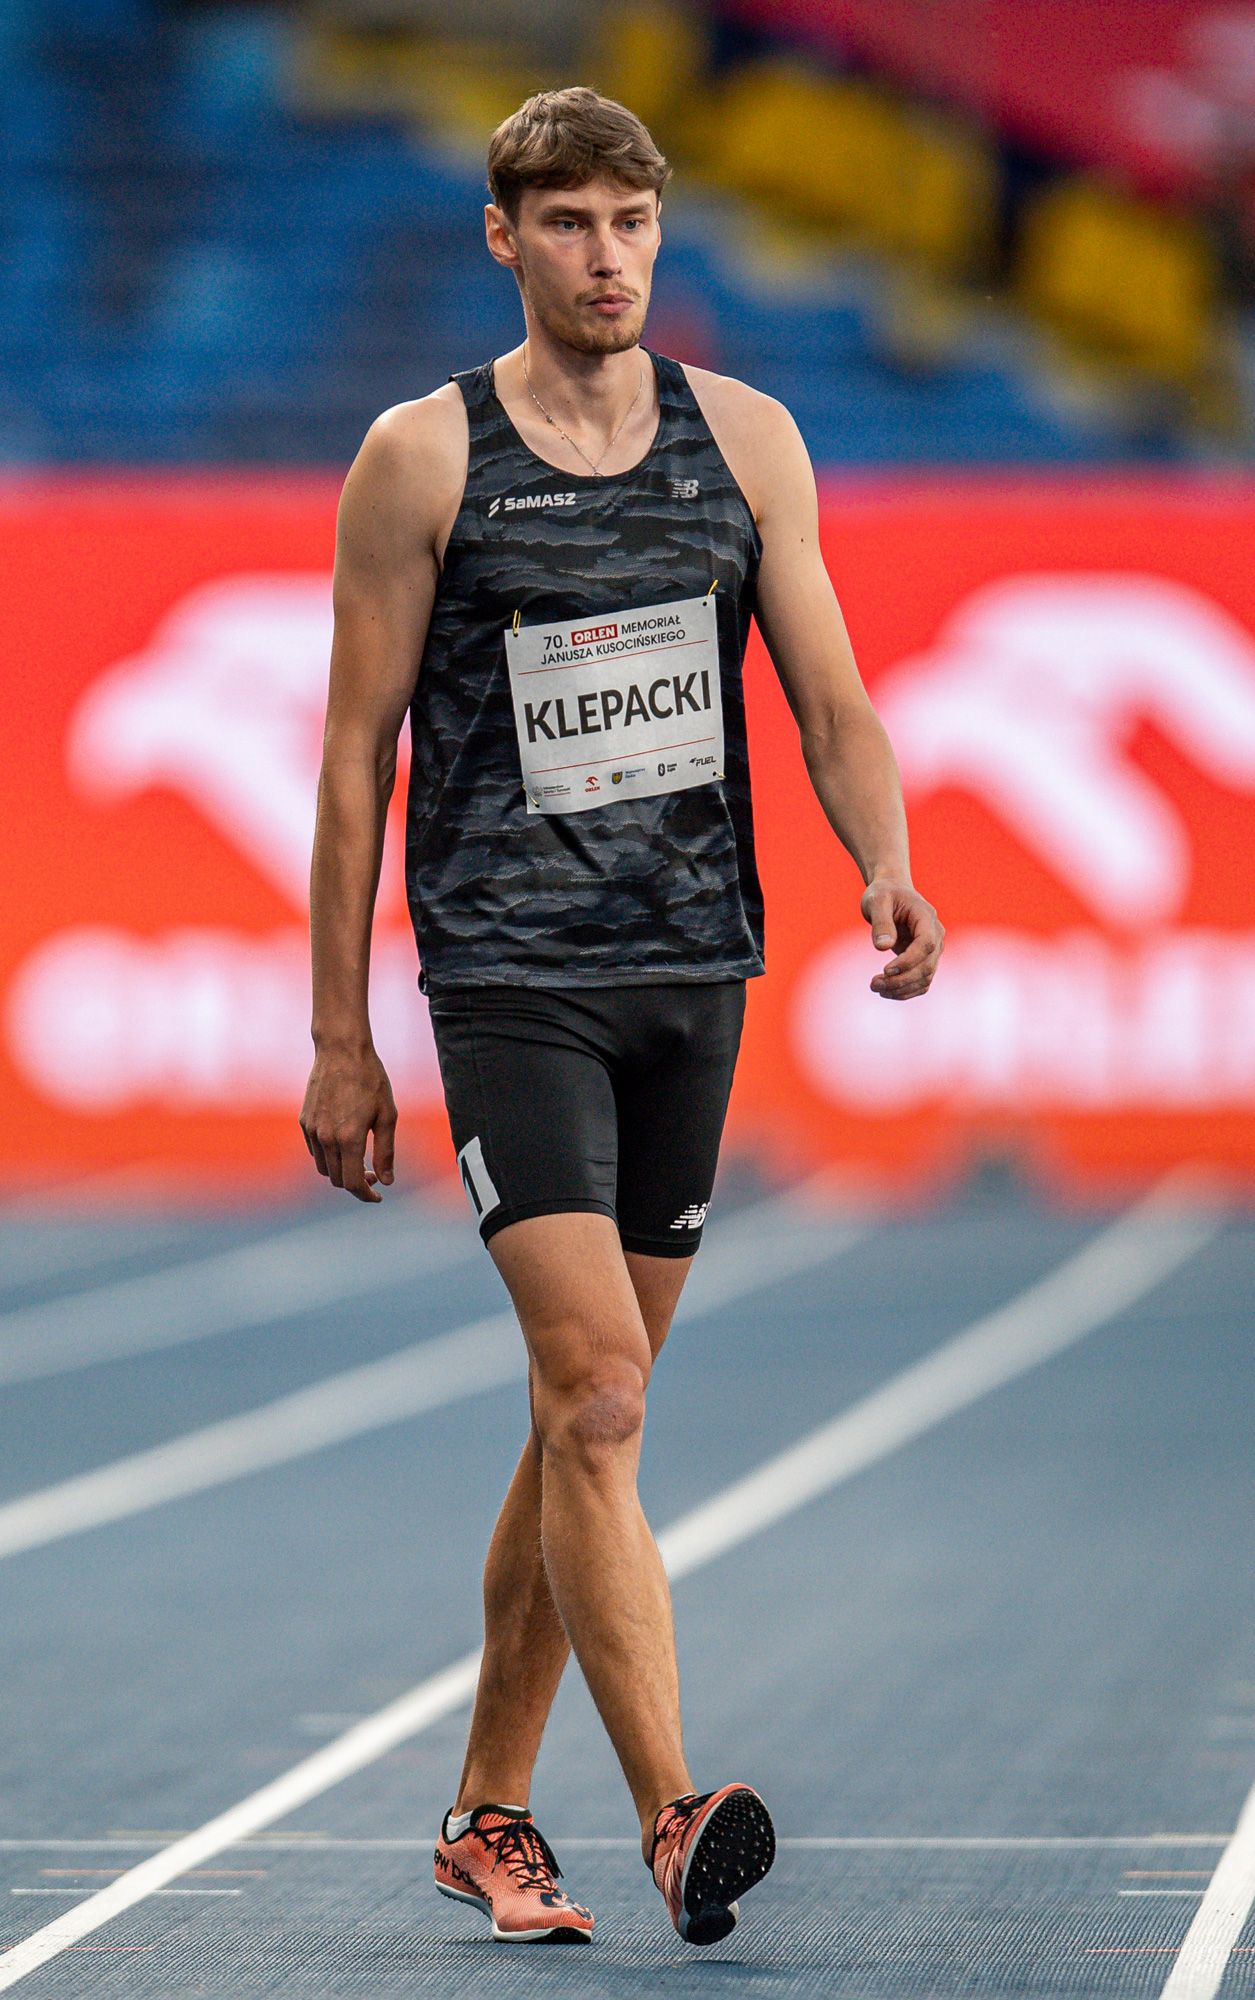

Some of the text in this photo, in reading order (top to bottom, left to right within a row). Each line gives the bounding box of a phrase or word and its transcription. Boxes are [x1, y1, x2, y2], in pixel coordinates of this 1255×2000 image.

[504, 492, 576, 511] SaMASZ
[541, 629, 686, 665] JANUSZA KUSOCIŃSKIEGO
[543, 615, 681, 650] 70. ORLEN MEMORIAŁ
[524, 670, 711, 743] KLEPACKI
[434, 1849, 450, 1873] ew
